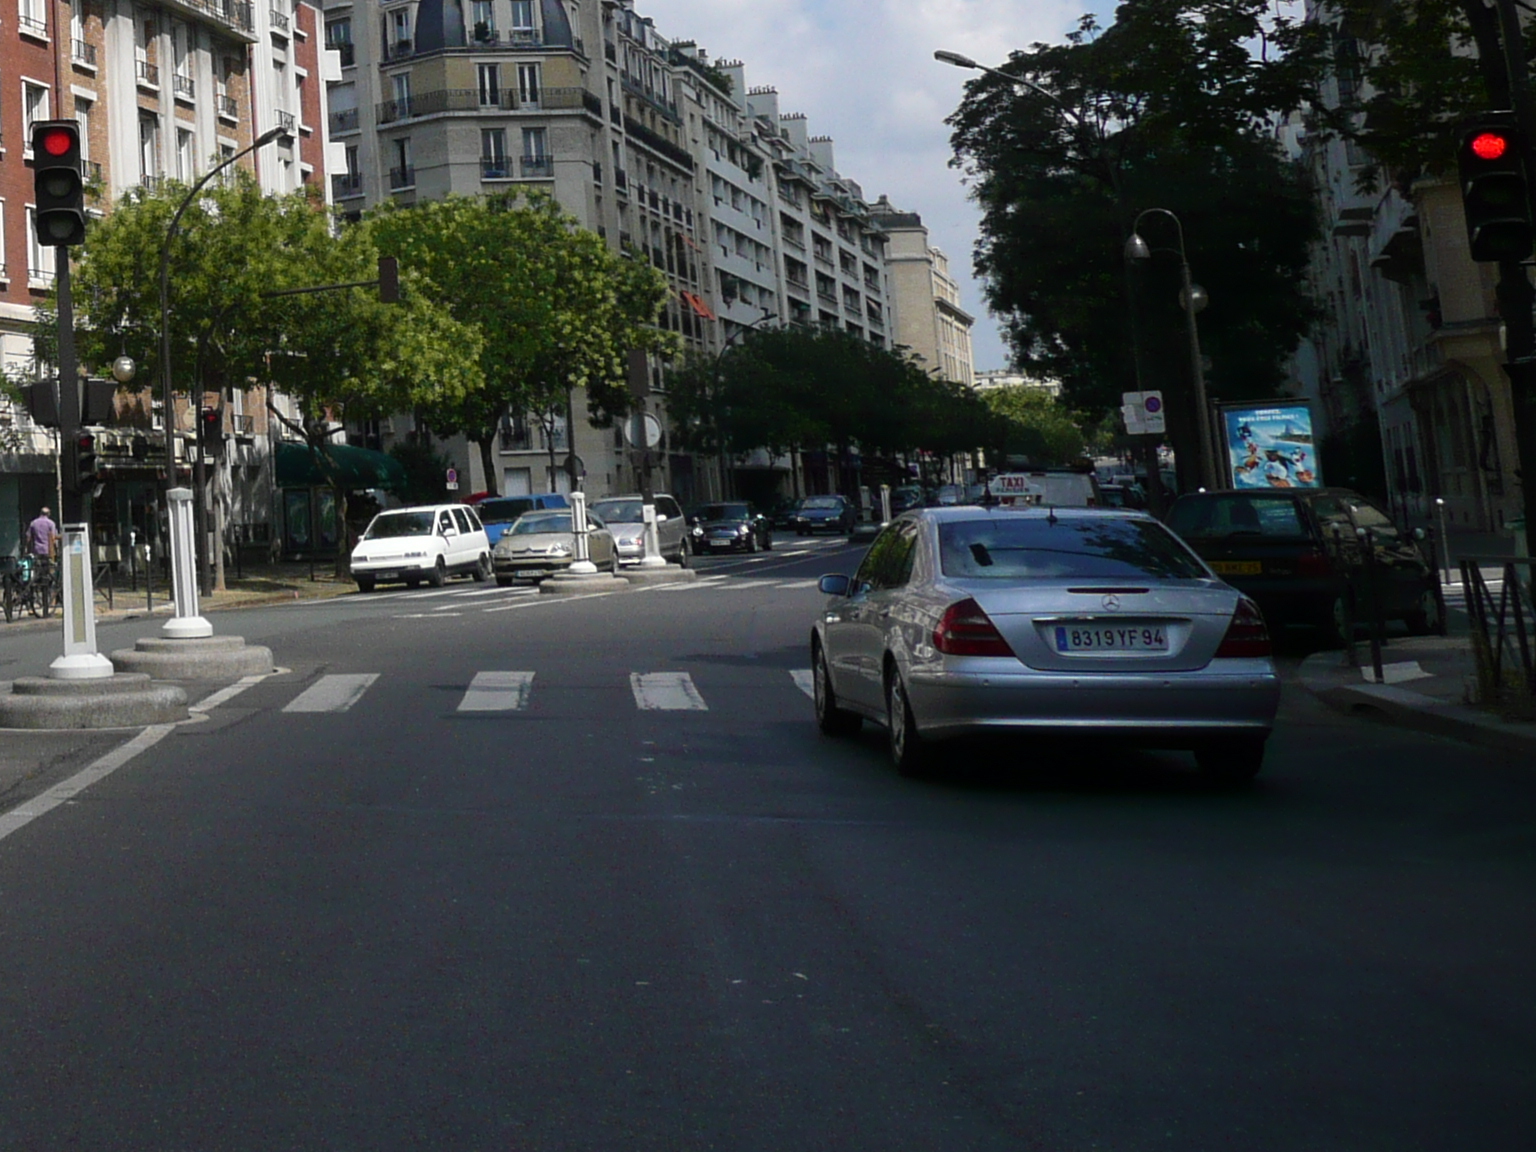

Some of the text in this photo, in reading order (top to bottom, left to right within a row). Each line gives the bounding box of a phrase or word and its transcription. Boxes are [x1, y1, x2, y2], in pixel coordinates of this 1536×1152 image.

[1000, 476, 1024, 487] TAXI
[1071, 629, 1163, 646] 8319 YF 94
